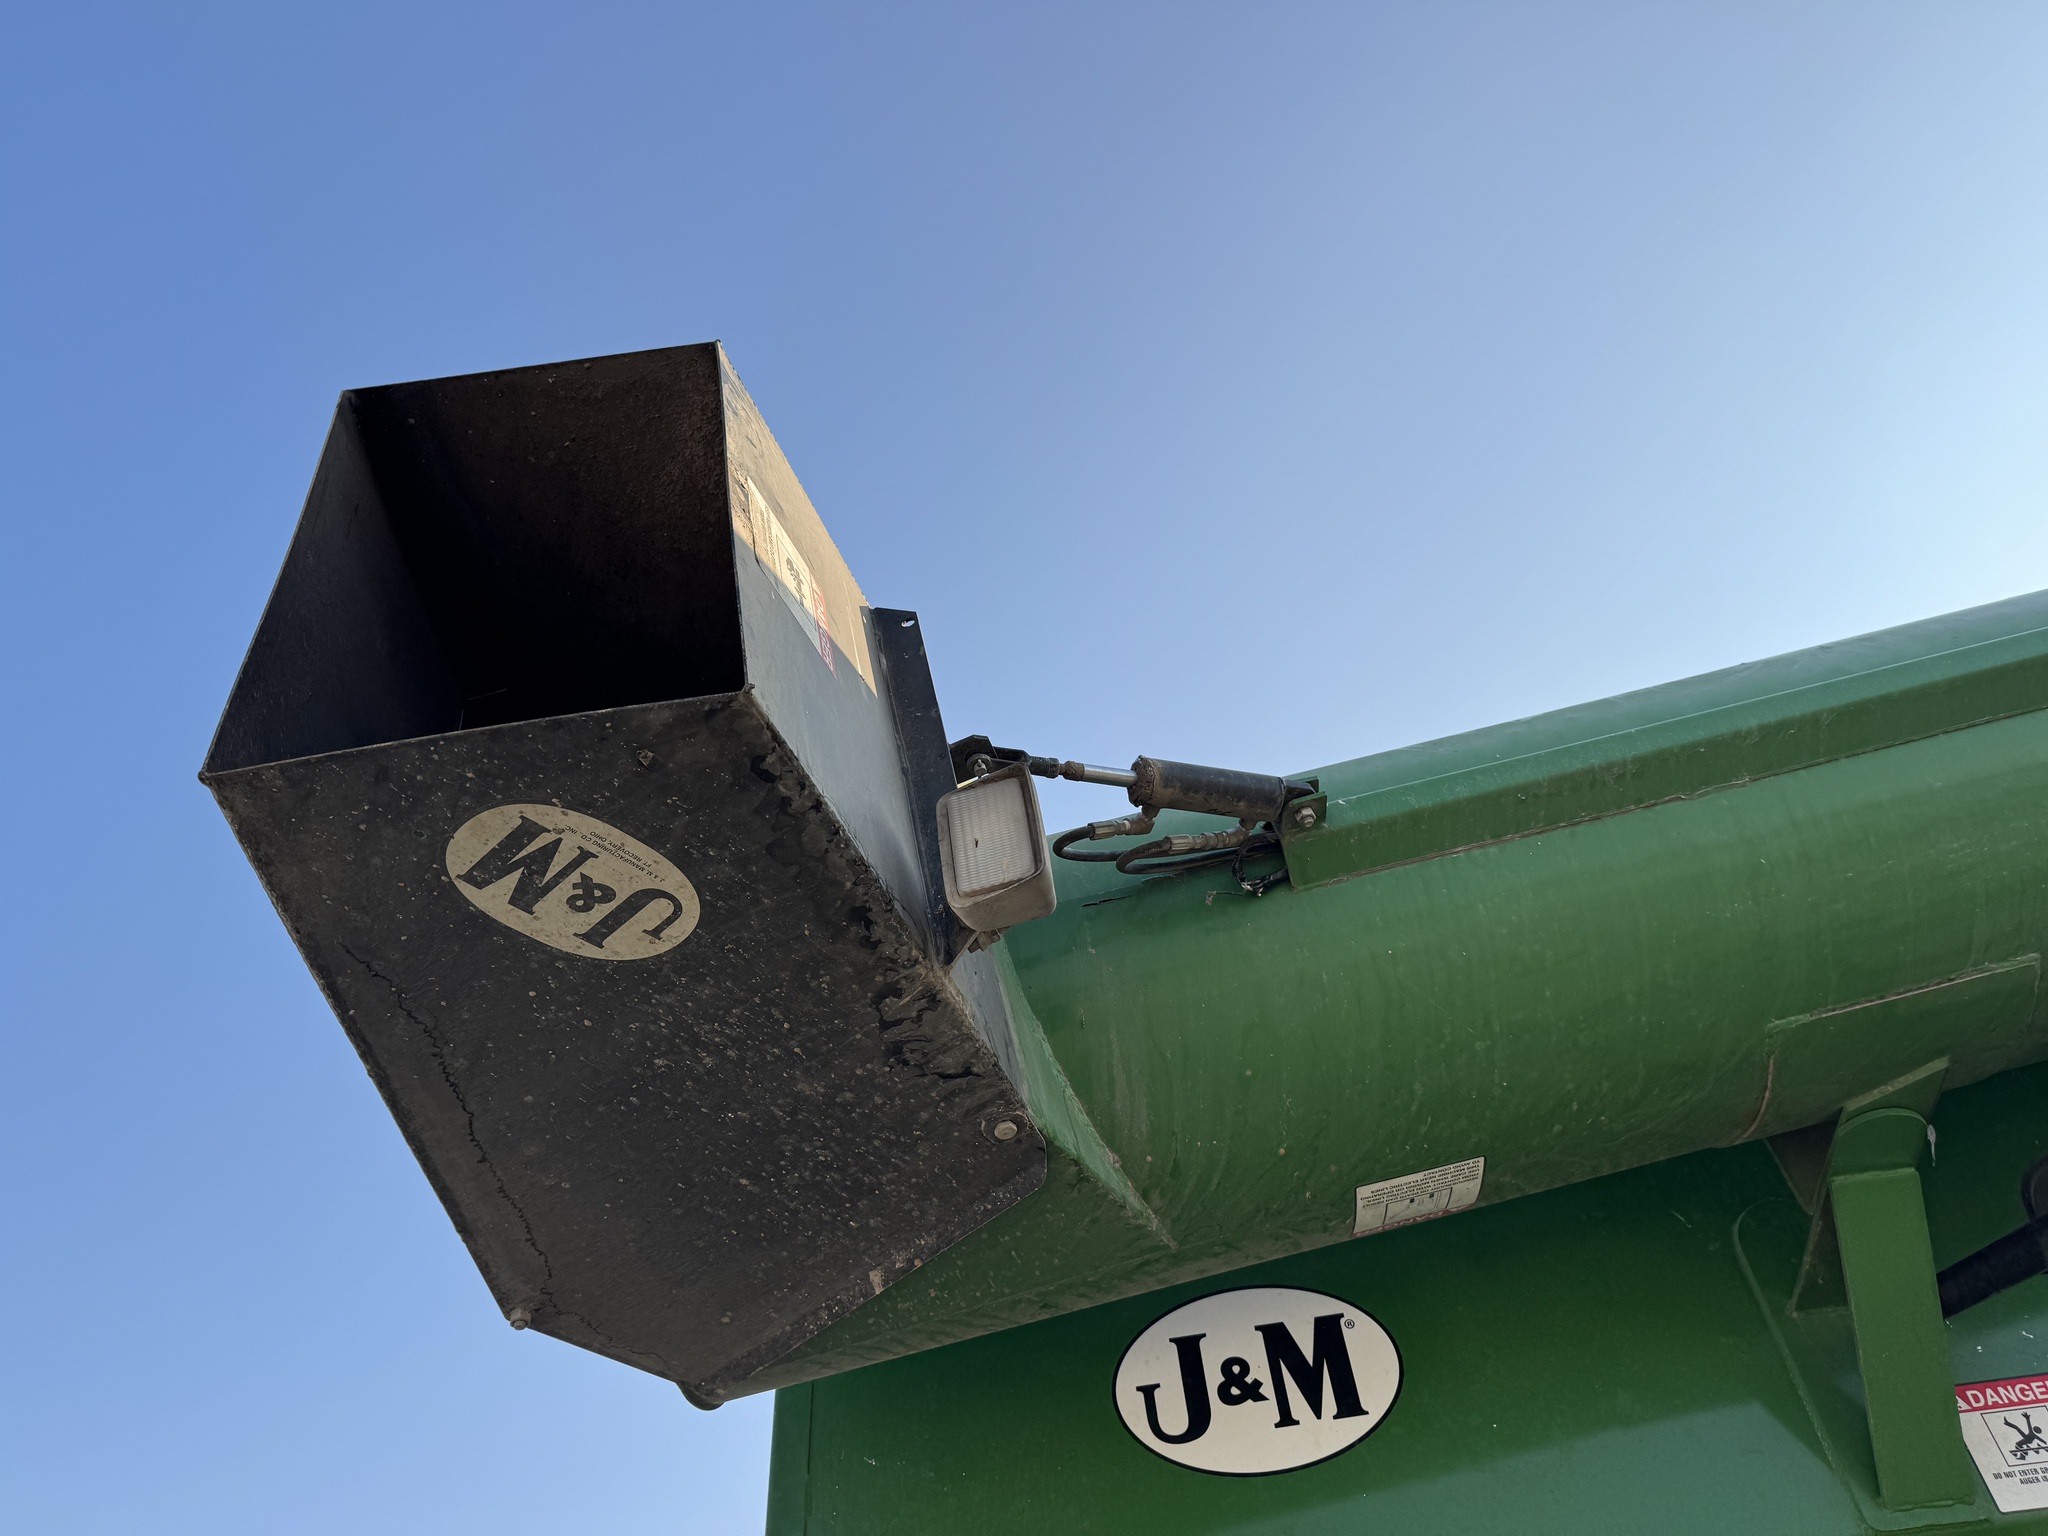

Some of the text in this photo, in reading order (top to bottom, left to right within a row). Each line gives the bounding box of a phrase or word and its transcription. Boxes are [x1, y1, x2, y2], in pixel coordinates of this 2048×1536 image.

[588, 830, 607, 842] OHIO
[591, 839, 646, 872] MANUFACTURING
[456, 815, 683, 949] J&M
[1438, 1168, 1465, 1177] MACHINE
[1389, 1180, 1418, 1189] ELECTRIC
[1432, 1178, 1460, 1187] CONTACT
[1360, 1190, 1394, 1200] OPERATING
[1136, 1313, 1369, 1444] J&M
[1966, 1380, 2048, 1407] DANGE
[2018, 1468, 2039, 1476] ENTER
[2020, 1475, 2040, 1485] AUGER
